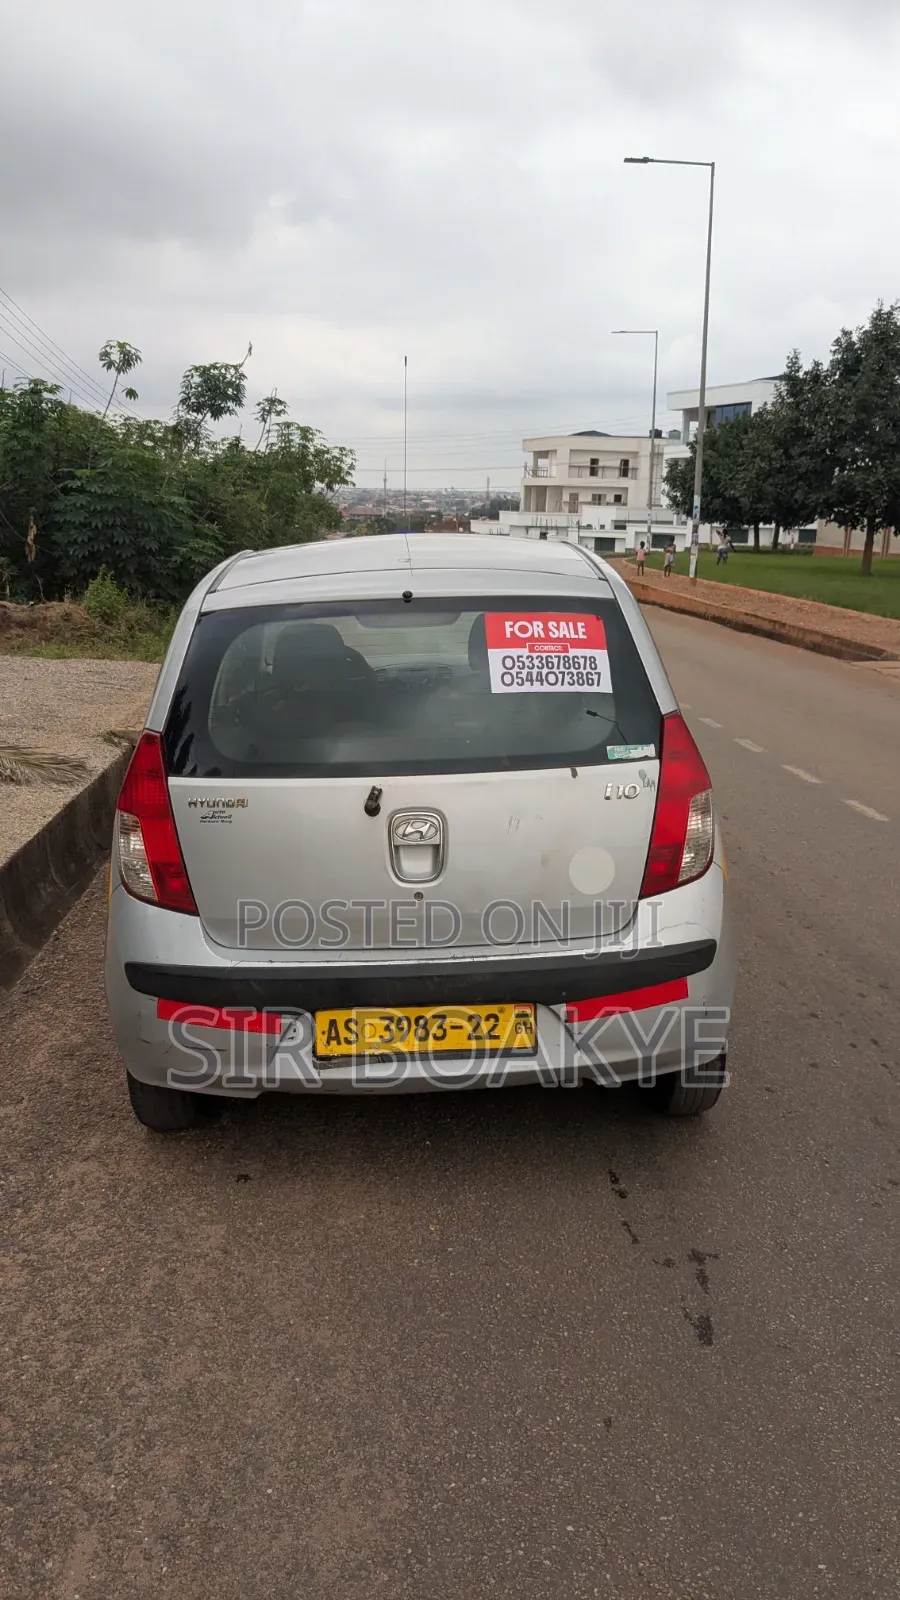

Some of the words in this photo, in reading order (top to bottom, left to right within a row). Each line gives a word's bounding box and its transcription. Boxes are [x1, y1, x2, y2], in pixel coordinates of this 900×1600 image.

[504, 621, 545, 639] FOR
[547, 622, 588, 639] SALE
[501, 655, 598, 671] 0533678678
[500, 671, 602, 687] 0544073867
[187, 797, 248, 808] HYUNDAI
[326, 1018, 359, 1046] AS
[378, 1013, 501, 1044] 3983-22
